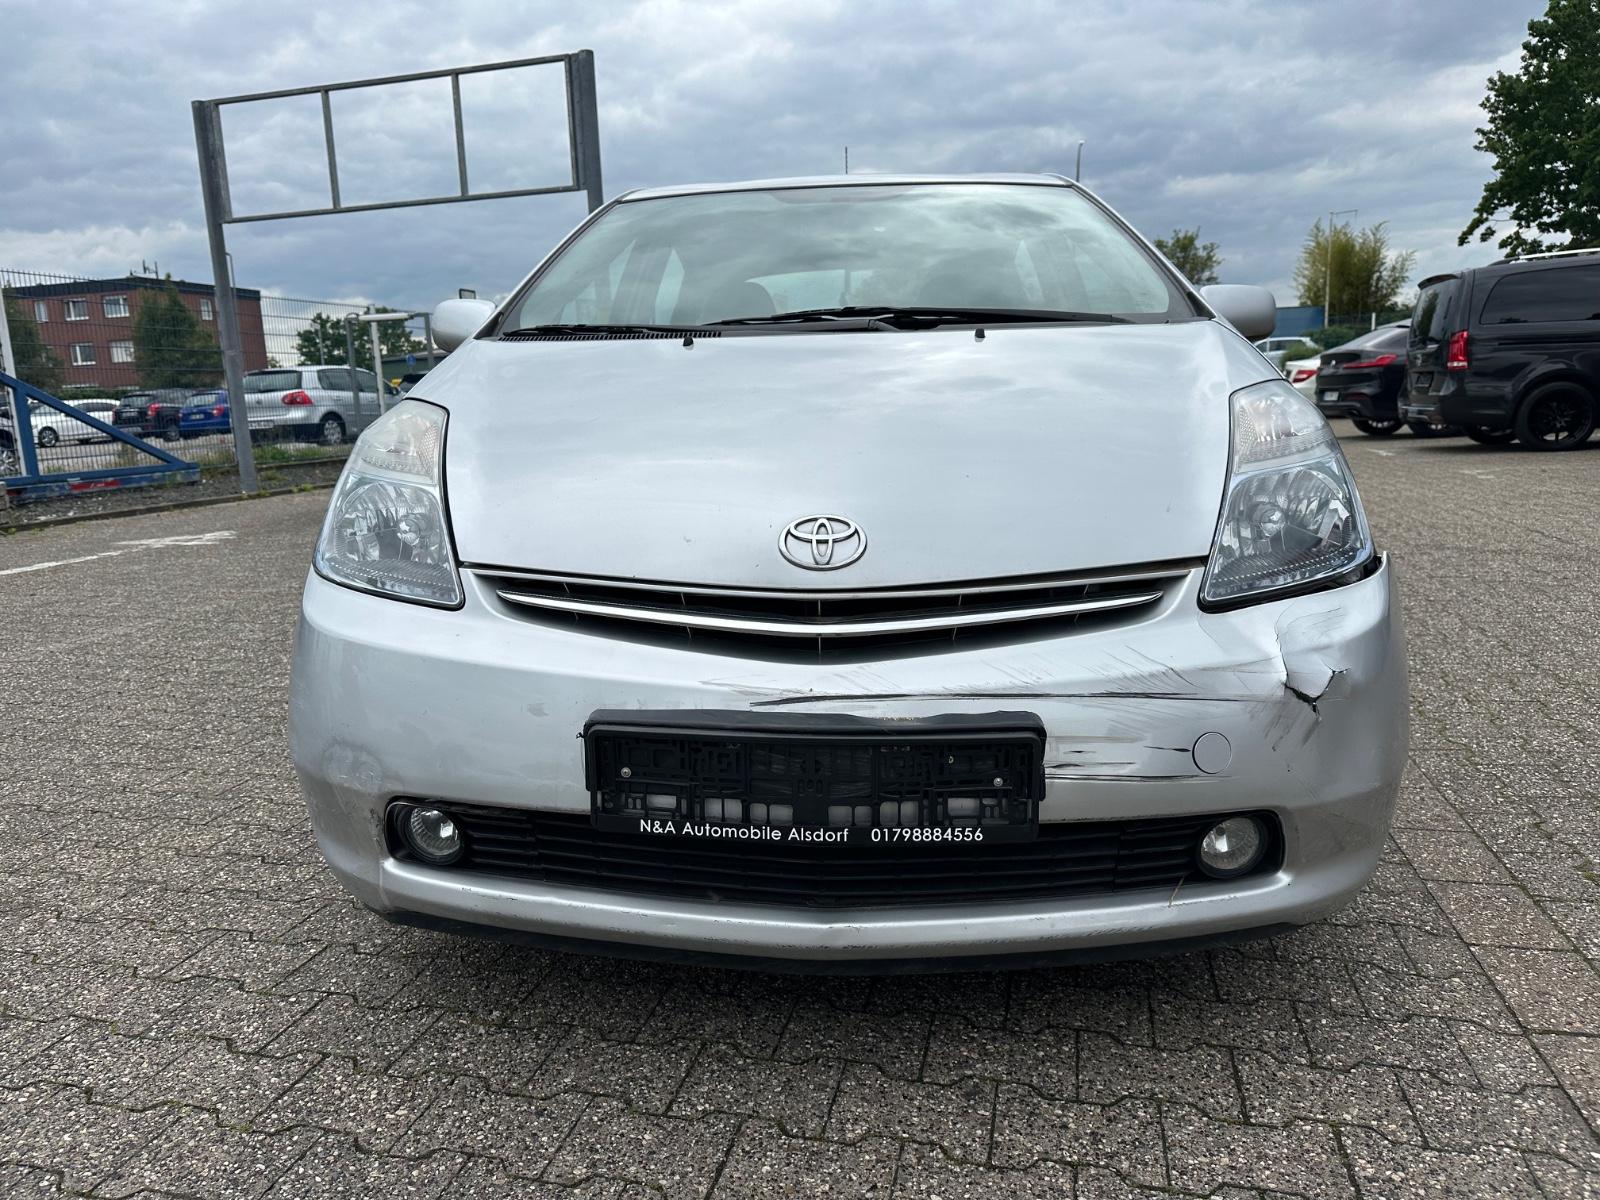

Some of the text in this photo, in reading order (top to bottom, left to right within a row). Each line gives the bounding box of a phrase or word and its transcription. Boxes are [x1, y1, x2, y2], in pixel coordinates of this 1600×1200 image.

[640, 819, 984, 842] N&A Automobile Alsdorf 01798884556
